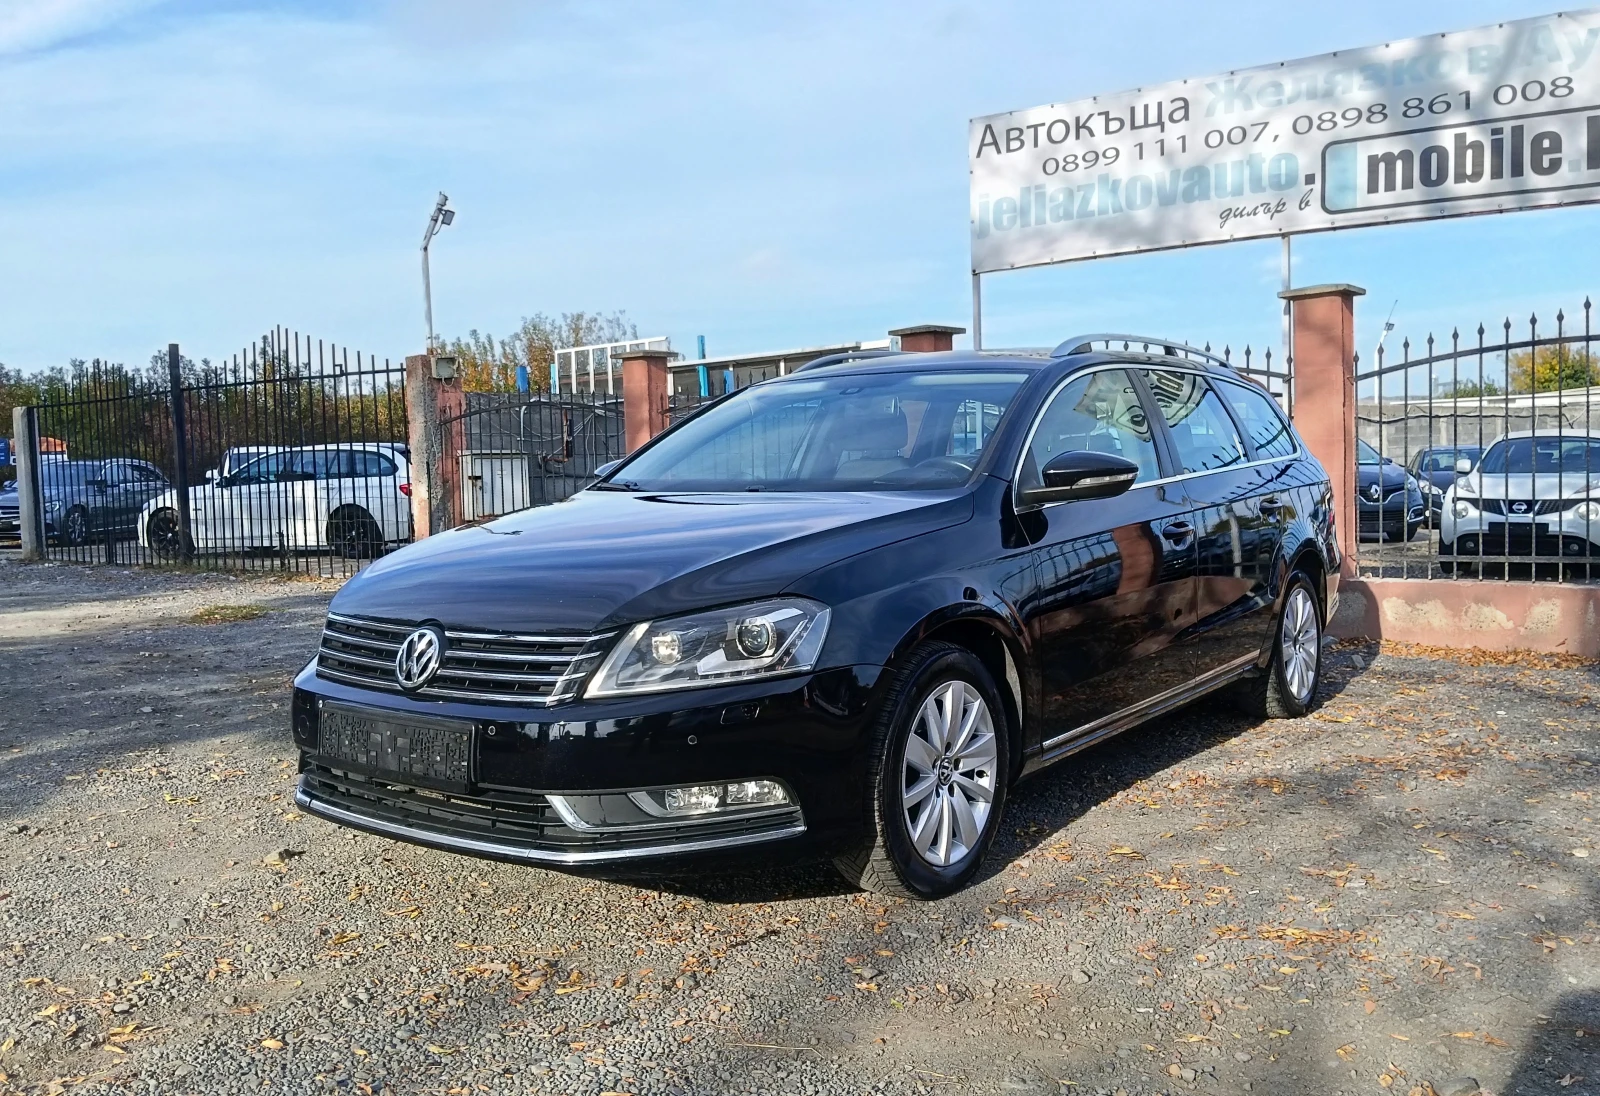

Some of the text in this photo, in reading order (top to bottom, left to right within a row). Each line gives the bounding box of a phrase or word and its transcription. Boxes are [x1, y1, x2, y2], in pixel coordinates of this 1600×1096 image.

[976, 96, 1190, 159] Автокъща
[1204, 43, 1501, 118] Желязков
[1042, 75, 1575, 176] 0899 111 007, 0898 861 008
[1219, 197, 1288, 229] дилър
